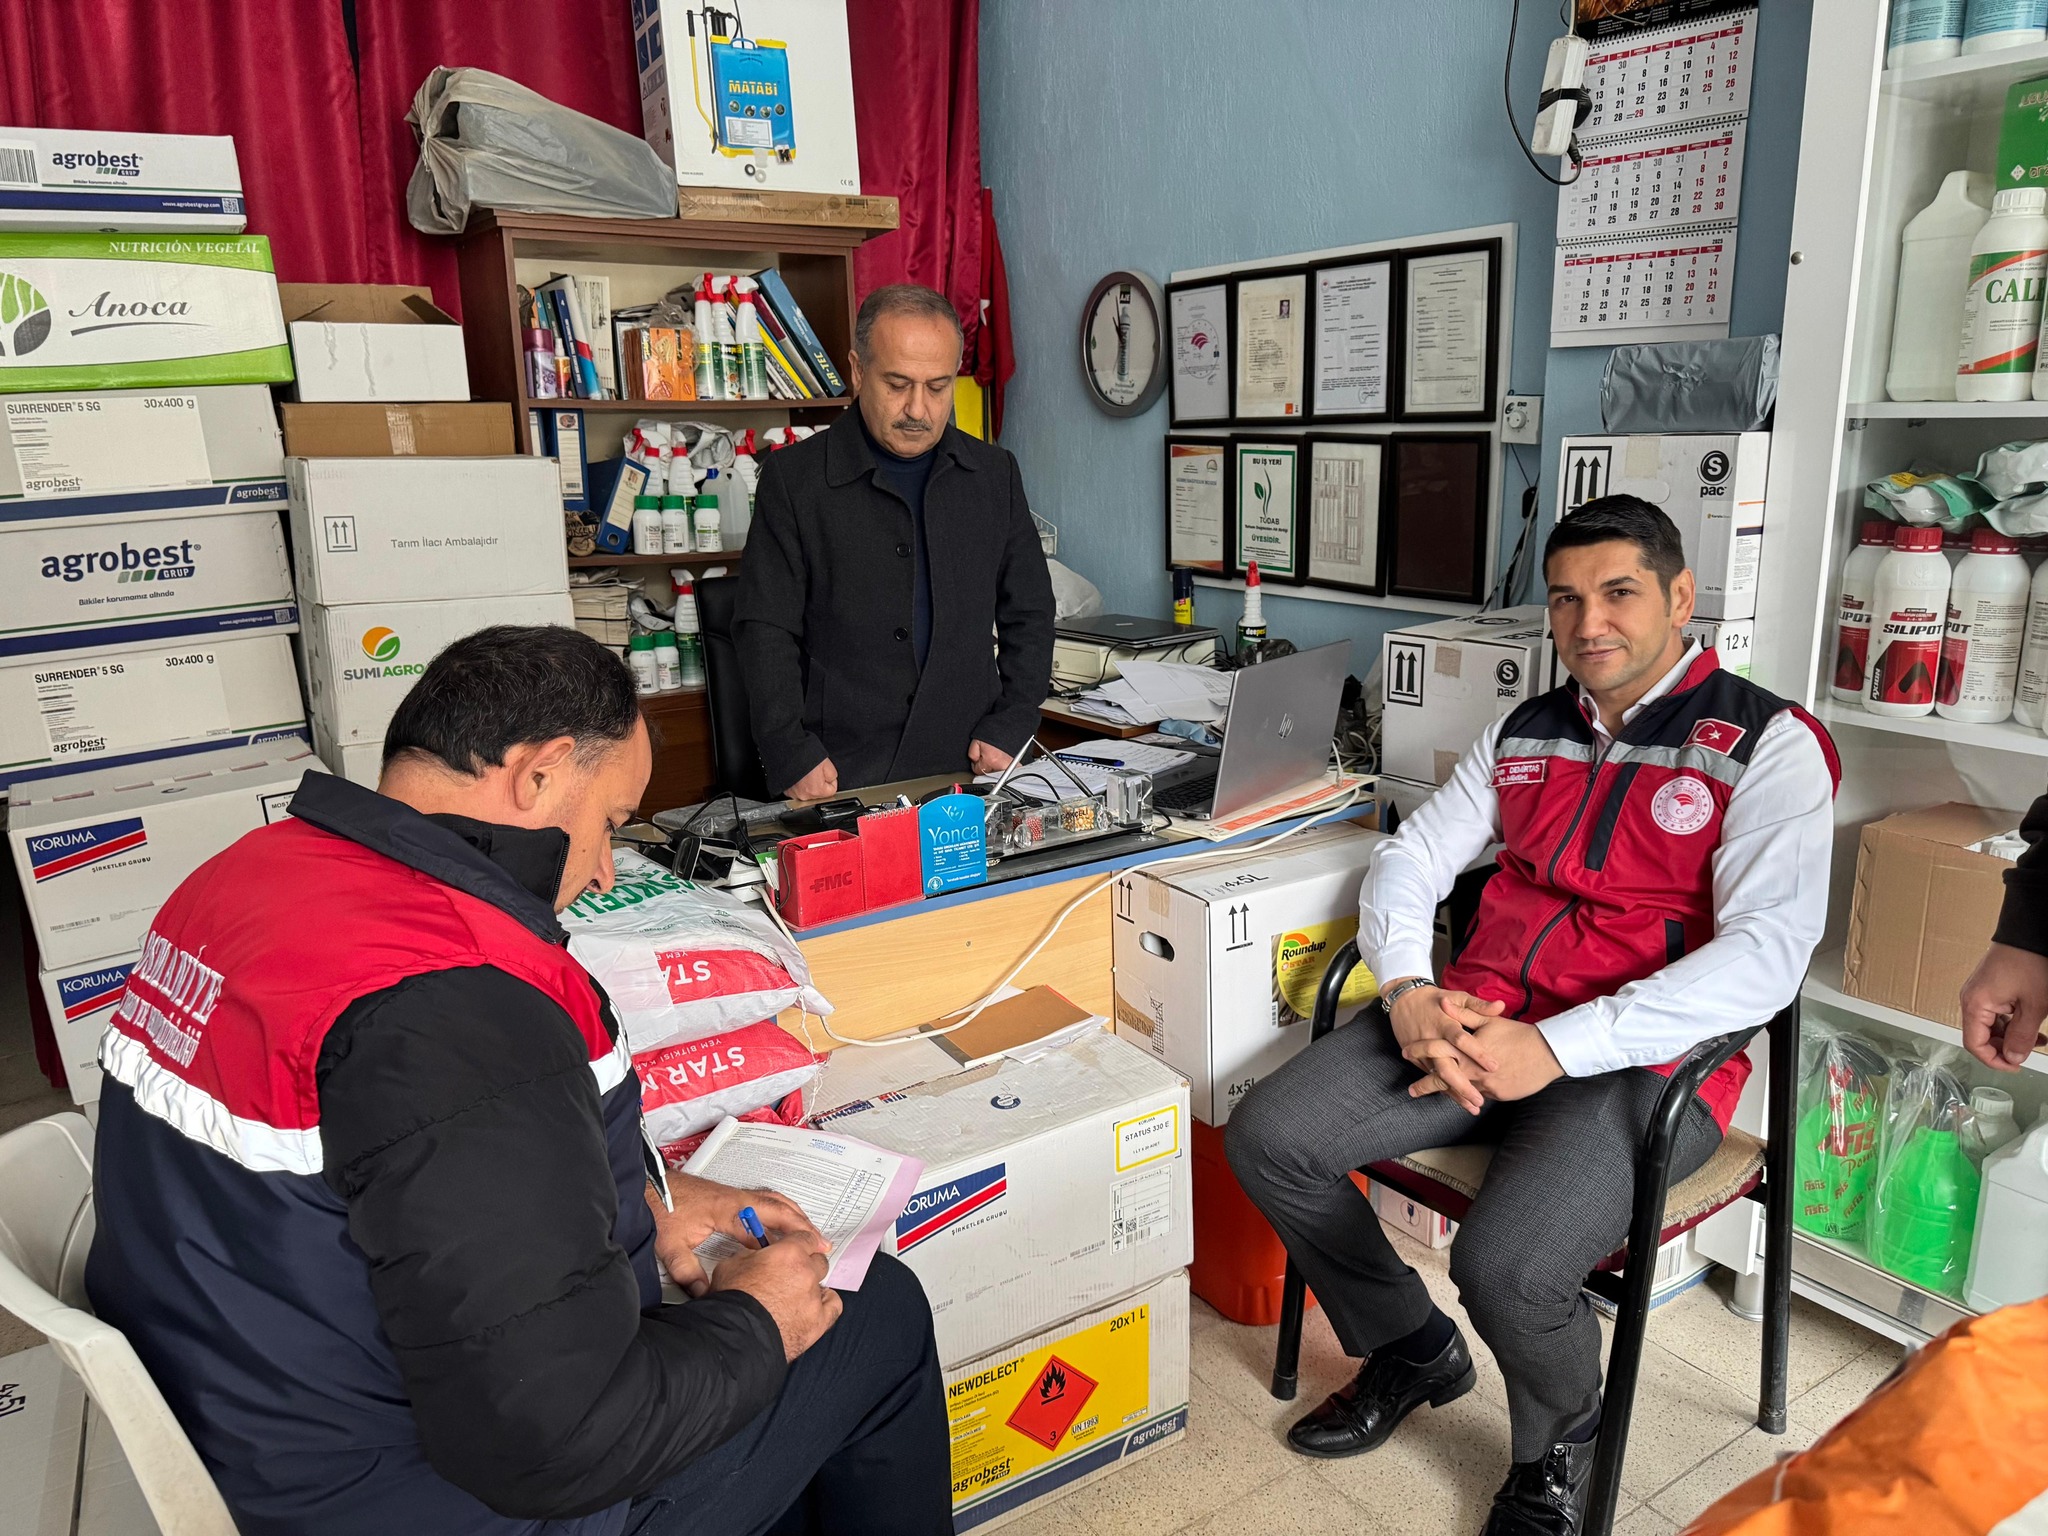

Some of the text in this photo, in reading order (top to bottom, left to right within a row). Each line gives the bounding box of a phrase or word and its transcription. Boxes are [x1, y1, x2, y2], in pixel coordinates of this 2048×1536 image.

[1645, 56, 1648, 64] 1
[1665, 51, 1670, 59] 2
[1688, 46, 1692, 55] 3
[1734, 36, 1739, 45] 5
[1600, 51, 1738, 86] 6 7 8 9 10 11 12
[1596, 64, 1736, 99] 13 14 15 16 17 18 19
[1594, 78, 1735, 112] 20 21 22 23 24 25 26
[1593, 101, 1688, 125] 27 28 29 30 31
[52, 150, 138, 170] agrobest
[109, 240, 260, 254] NUTRICIÓN VEGETAL
[1692, 256, 1696, 264] 6
[1715, 254, 1719, 262] 7
[1666, 272, 1673, 280] 12
[1688, 270, 1695, 278] 13
[1710, 268, 1717, 276] 14
[1665, 284, 1672, 292] 19
[1686, 283, 1694, 291] 20
[1708, 281, 1716, 289] 21
[69, 292, 192, 317] Anoca
[1662, 297, 1671, 305] 26
[1684, 296, 1693, 304] 27
[1706, 294, 1715, 302] 28
[8, 403, 73, 414] SURRENDER
[78, 402, 84, 411] 5
[86, 402, 101, 411] SG
[1708, 458, 1722, 475] S
[26, 477, 80, 490] agrobest
[1700, 486, 1724, 497] pac
[236, 486, 279, 499] agrobest
[391, 536, 498, 548] Tarım İlacı Ambalajıdır
[41, 540, 194, 582] agrobest
[163, 568, 190, 578] GRUP
[1883, 624, 1942, 635] SILIPOT
[1725, 635, 1737, 650] 12
[166, 654, 214, 667] 30x400 g
[35, 664, 124, 684] SURRENDER 5 SG
[1503, 666, 1514, 680] S
[1497, 688, 1517, 698] pac
[53, 736, 104, 753] agrobest
[32, 830, 96, 852] KORUMA
[928, 825, 979, 846] Yonca
[128, 856, 151, 866] GRUBU
[812, 870, 852, 893] FMC
[1282, 941, 1326, 960] Roundup
[63, 970, 125, 993] KORUMA
[668, 1046, 745, 1086] STAR
[1125, 1126, 1151, 1141] STATUS
[1140, 1307, 1146, 1319] L
[949, 1360, 1019, 1398] NEWDELECT
[1050, 1431, 1057, 1441] 3
[1132, 1416, 1177, 1445] agrobest
[952, 1457, 1010, 1492] agrobest
